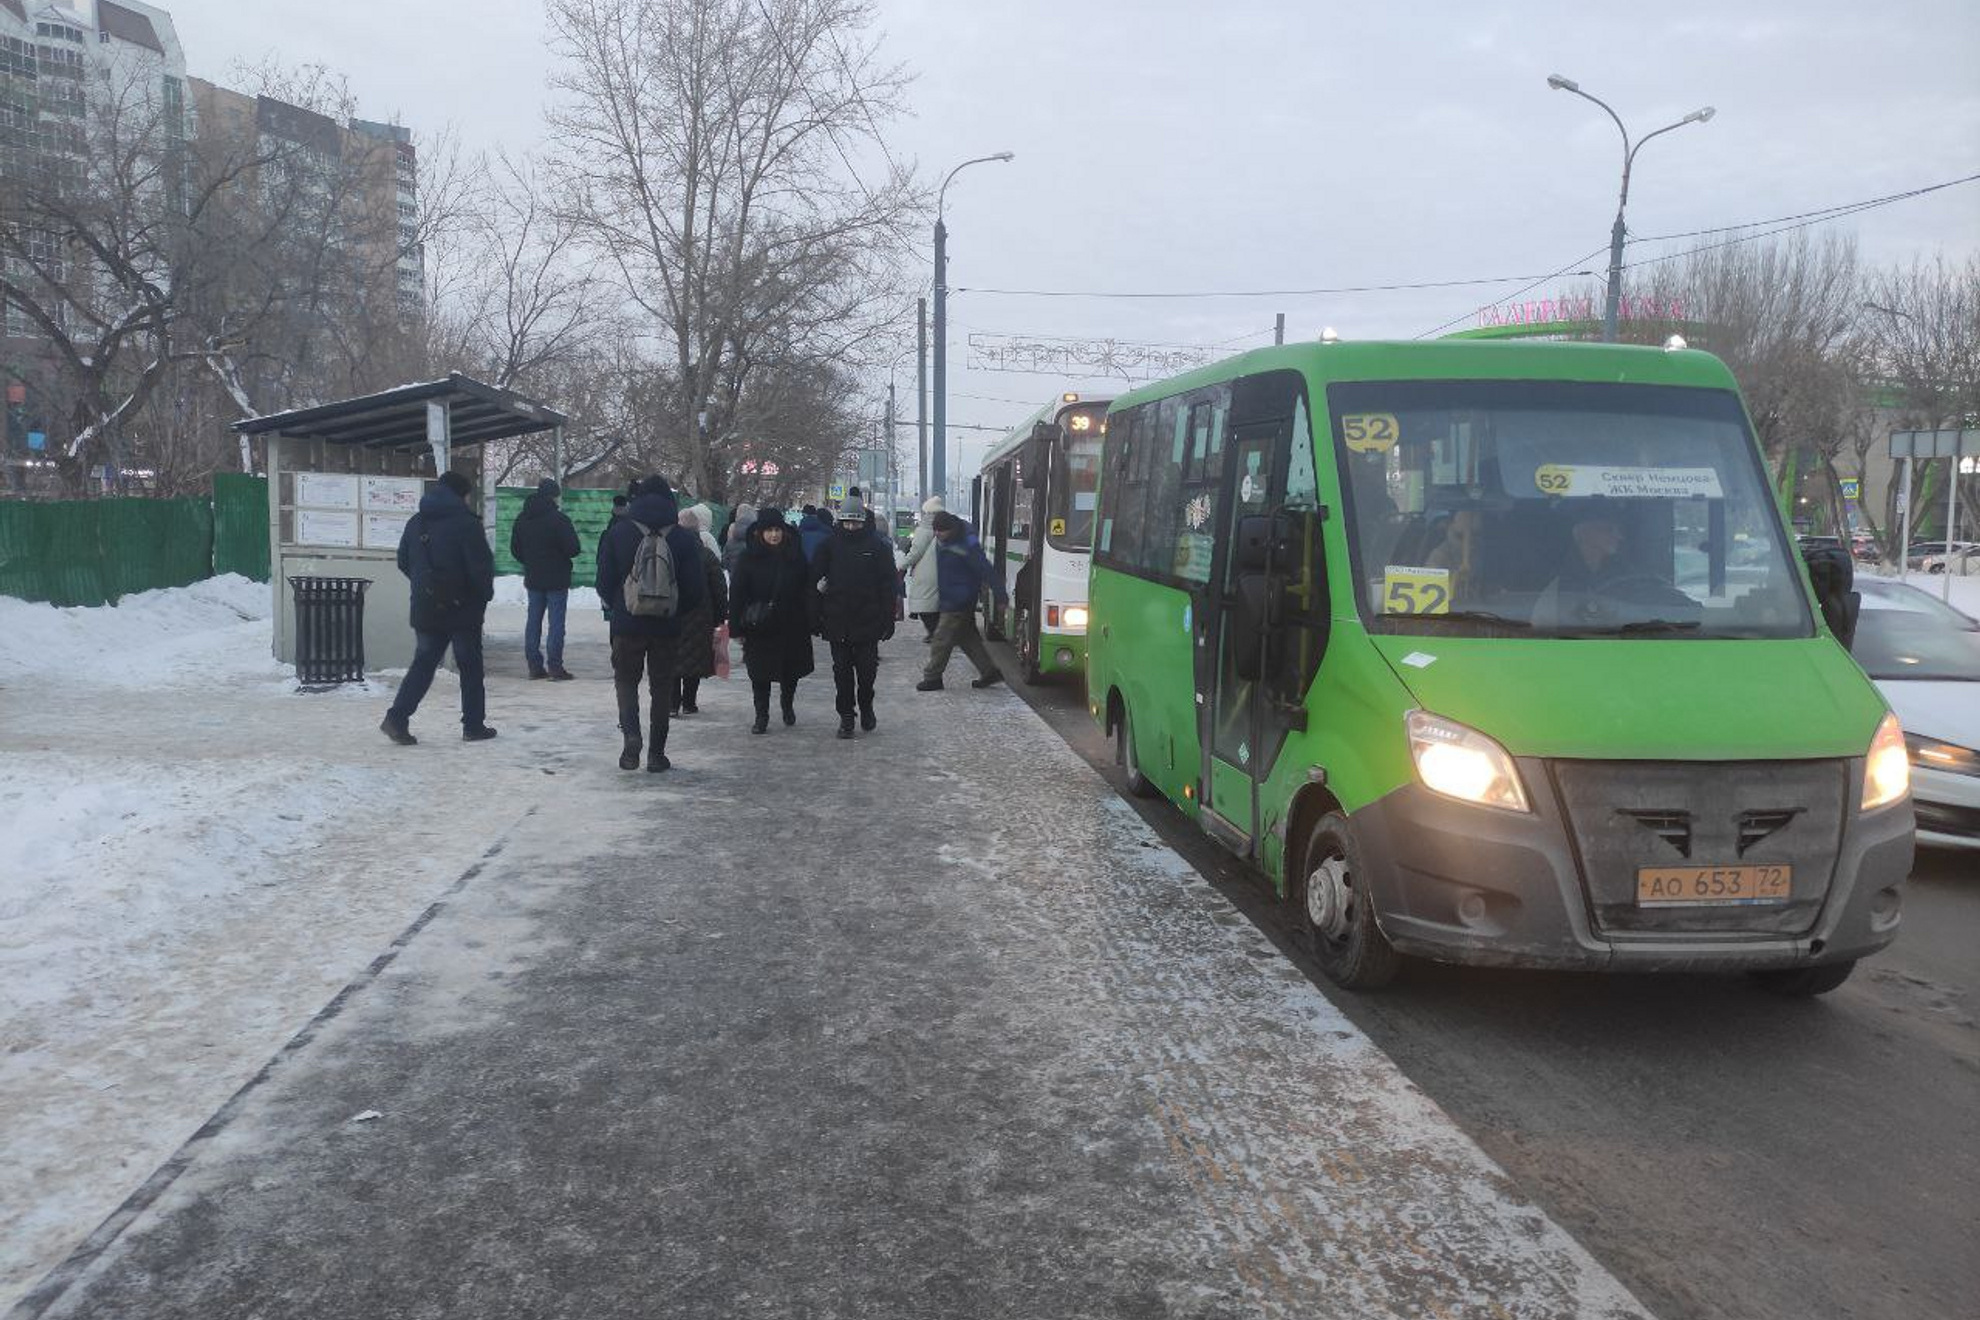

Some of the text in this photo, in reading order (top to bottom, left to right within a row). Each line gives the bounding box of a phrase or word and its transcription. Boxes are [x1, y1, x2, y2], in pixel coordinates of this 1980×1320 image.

[1071, 416, 1090, 430] 39
[1344, 418, 1393, 440] 52
[1540, 474, 1570, 490] 52
[1601, 472, 1644, 484] Сквер
[1609, 485, 1690, 496] ЖК Москва
[1387, 582, 1447, 614] 52
[1650, 868, 1782, 896] АО 653 72
